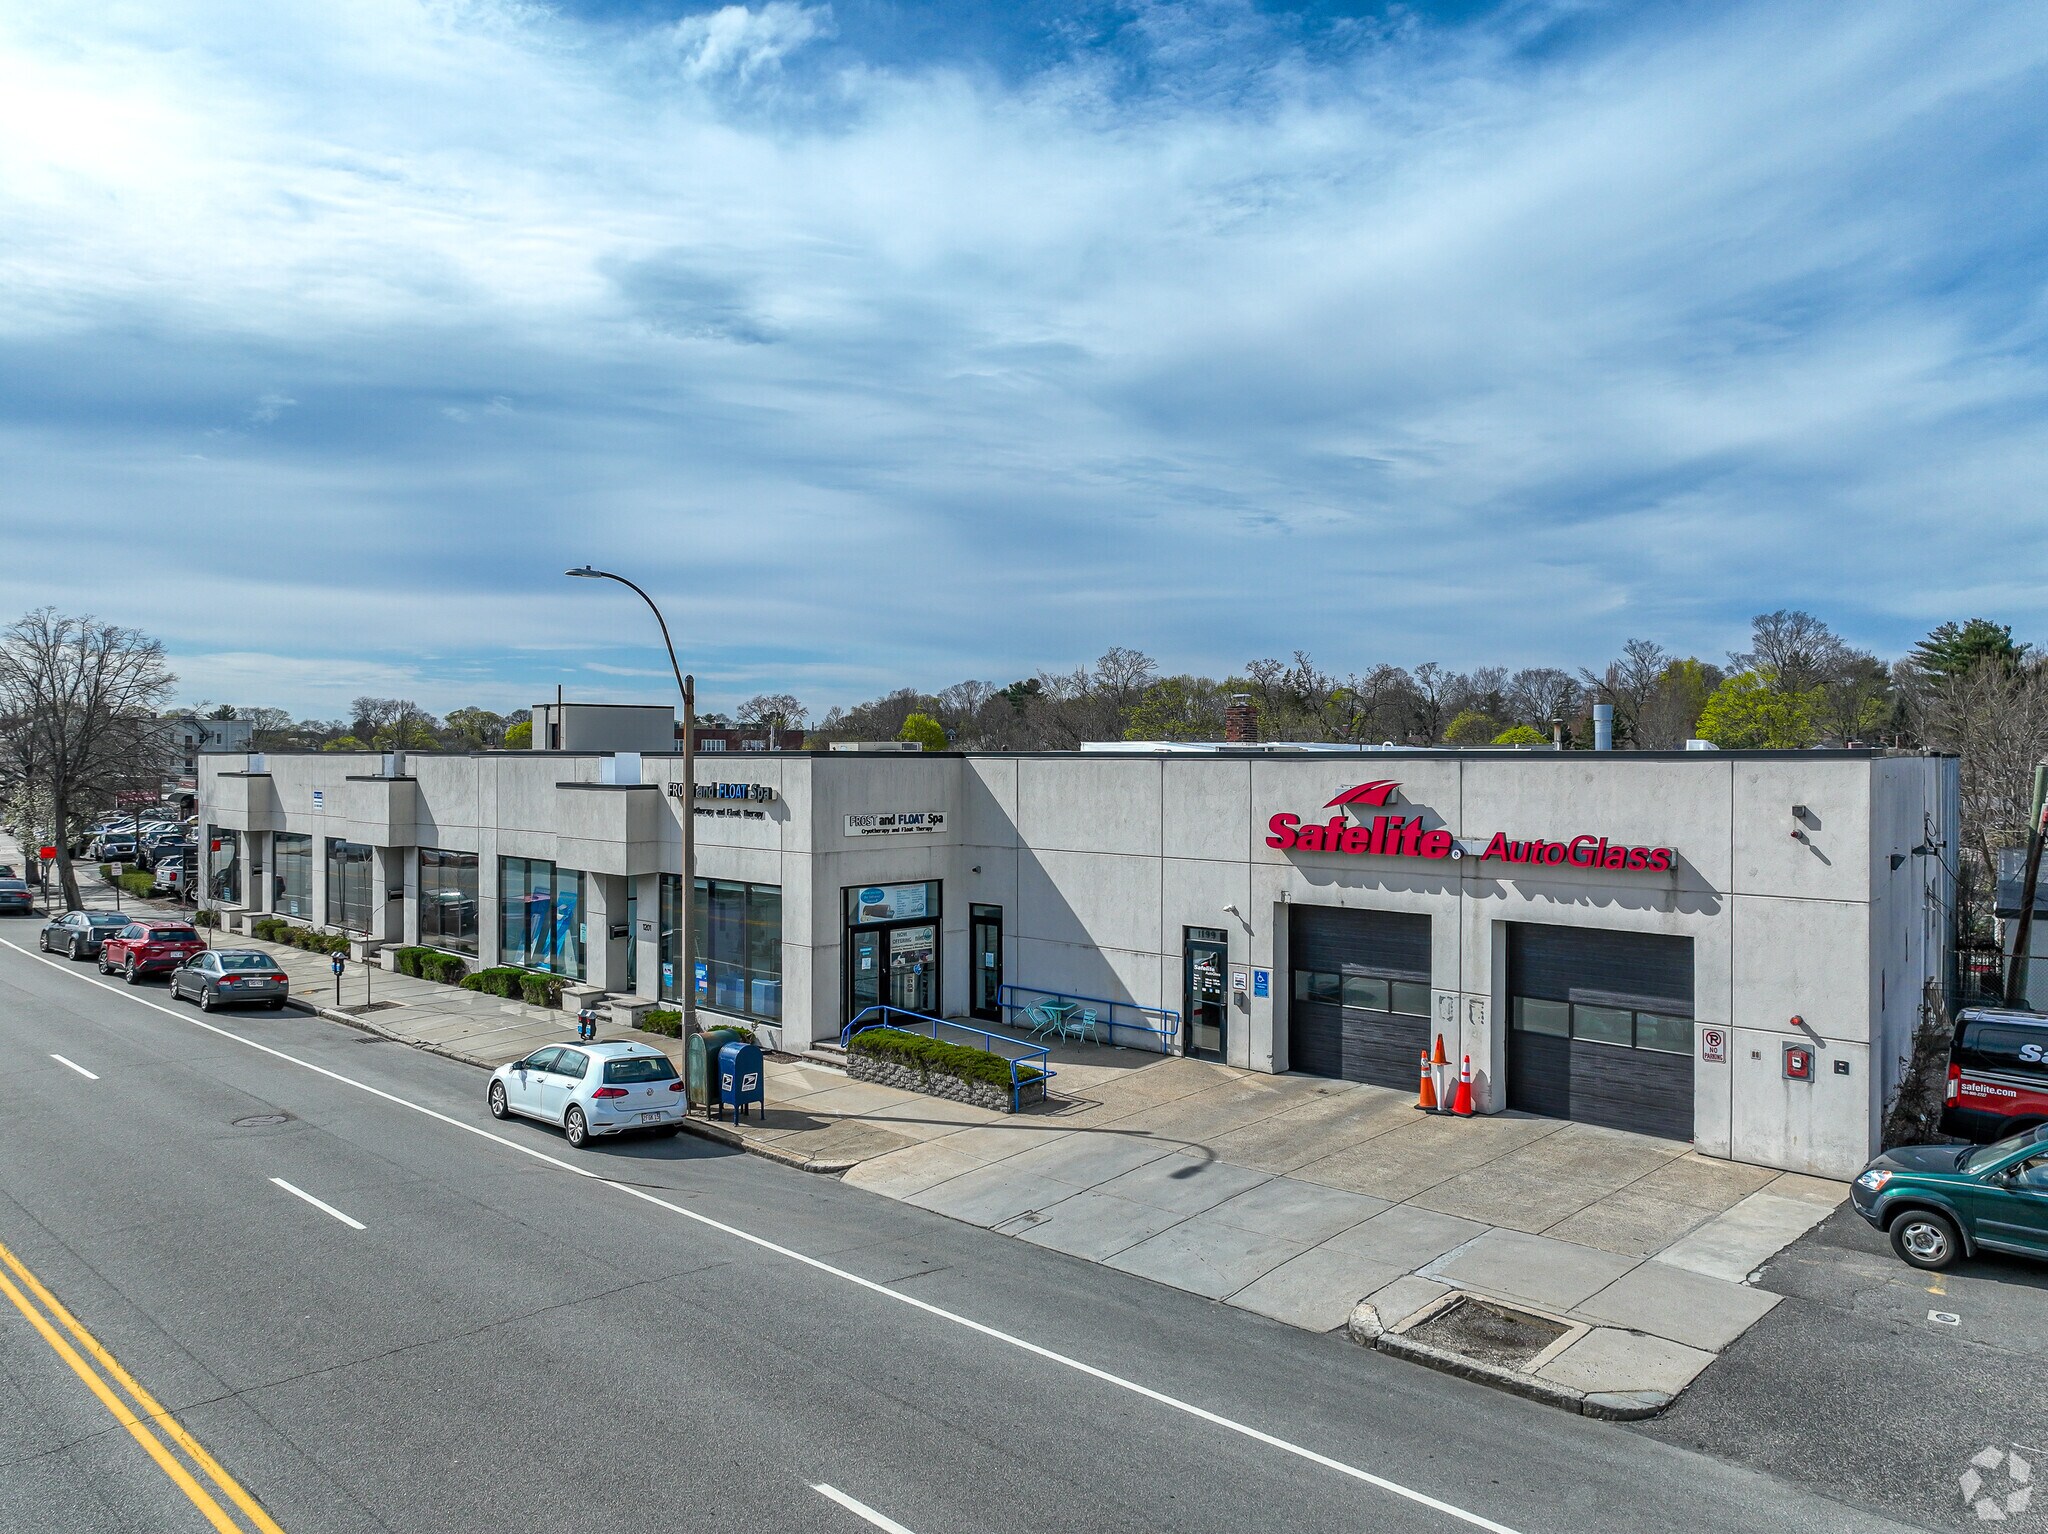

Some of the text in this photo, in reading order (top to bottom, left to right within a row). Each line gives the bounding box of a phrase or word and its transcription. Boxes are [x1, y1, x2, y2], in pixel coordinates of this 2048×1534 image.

[668, 782, 772, 803] FROT and FLOAT Spa
[850, 813, 944, 827] FROST and FLOAT Spa
[861, 827, 890, 835] Cryotherapy
[916, 825, 934, 833] Therapy
[1480, 832, 1671, 872] AutoGlass
[642, 923, 652, 932] 1201
[1198, 930, 1217, 940] 1199
[1709, 1046, 1719, 1054] NO
[1704, 1052, 1724, 1061] PARKING
[1961, 1082, 2018, 1098] safelite.com
